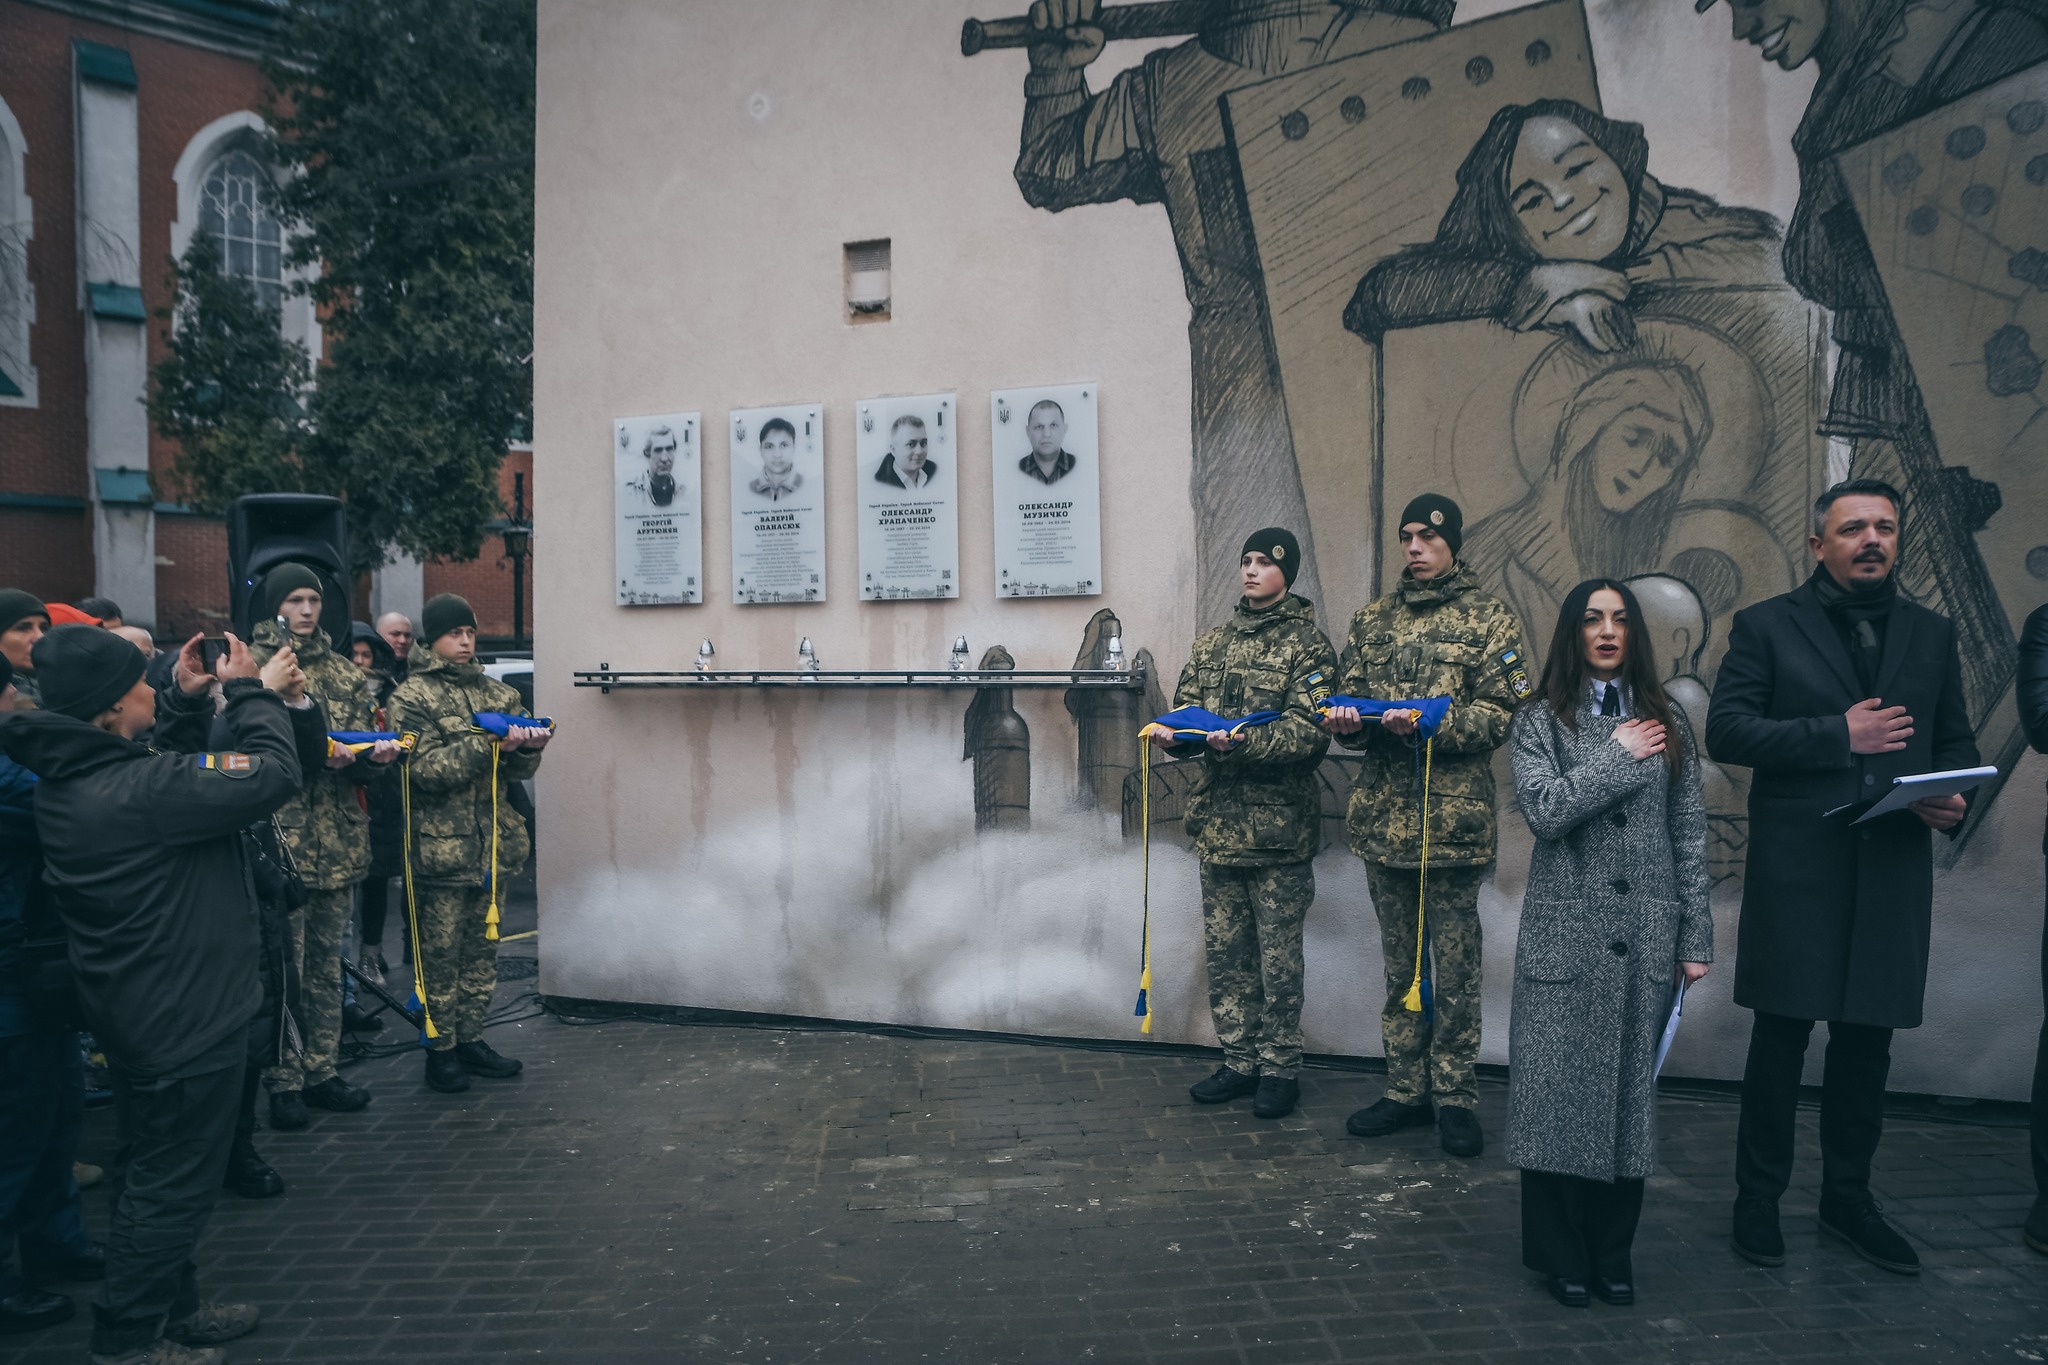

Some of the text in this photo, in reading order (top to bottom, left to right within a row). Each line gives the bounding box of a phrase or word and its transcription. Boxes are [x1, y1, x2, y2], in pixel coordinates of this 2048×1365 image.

[1018, 502, 1073, 510] ОЛЕКСАНДР
[881, 508, 933, 517] ОЛЕКСАНДР
[1023, 510, 1068, 519] МУЗИЧКО
[760, 513, 794, 522] ВАЛЕРІЙ
[878, 516, 936, 525] ХРАПАЧЕНКО
[642, 518, 672, 527] ГЕОРГІЙ
[754, 523, 800, 531] ОПАНАСЮК
